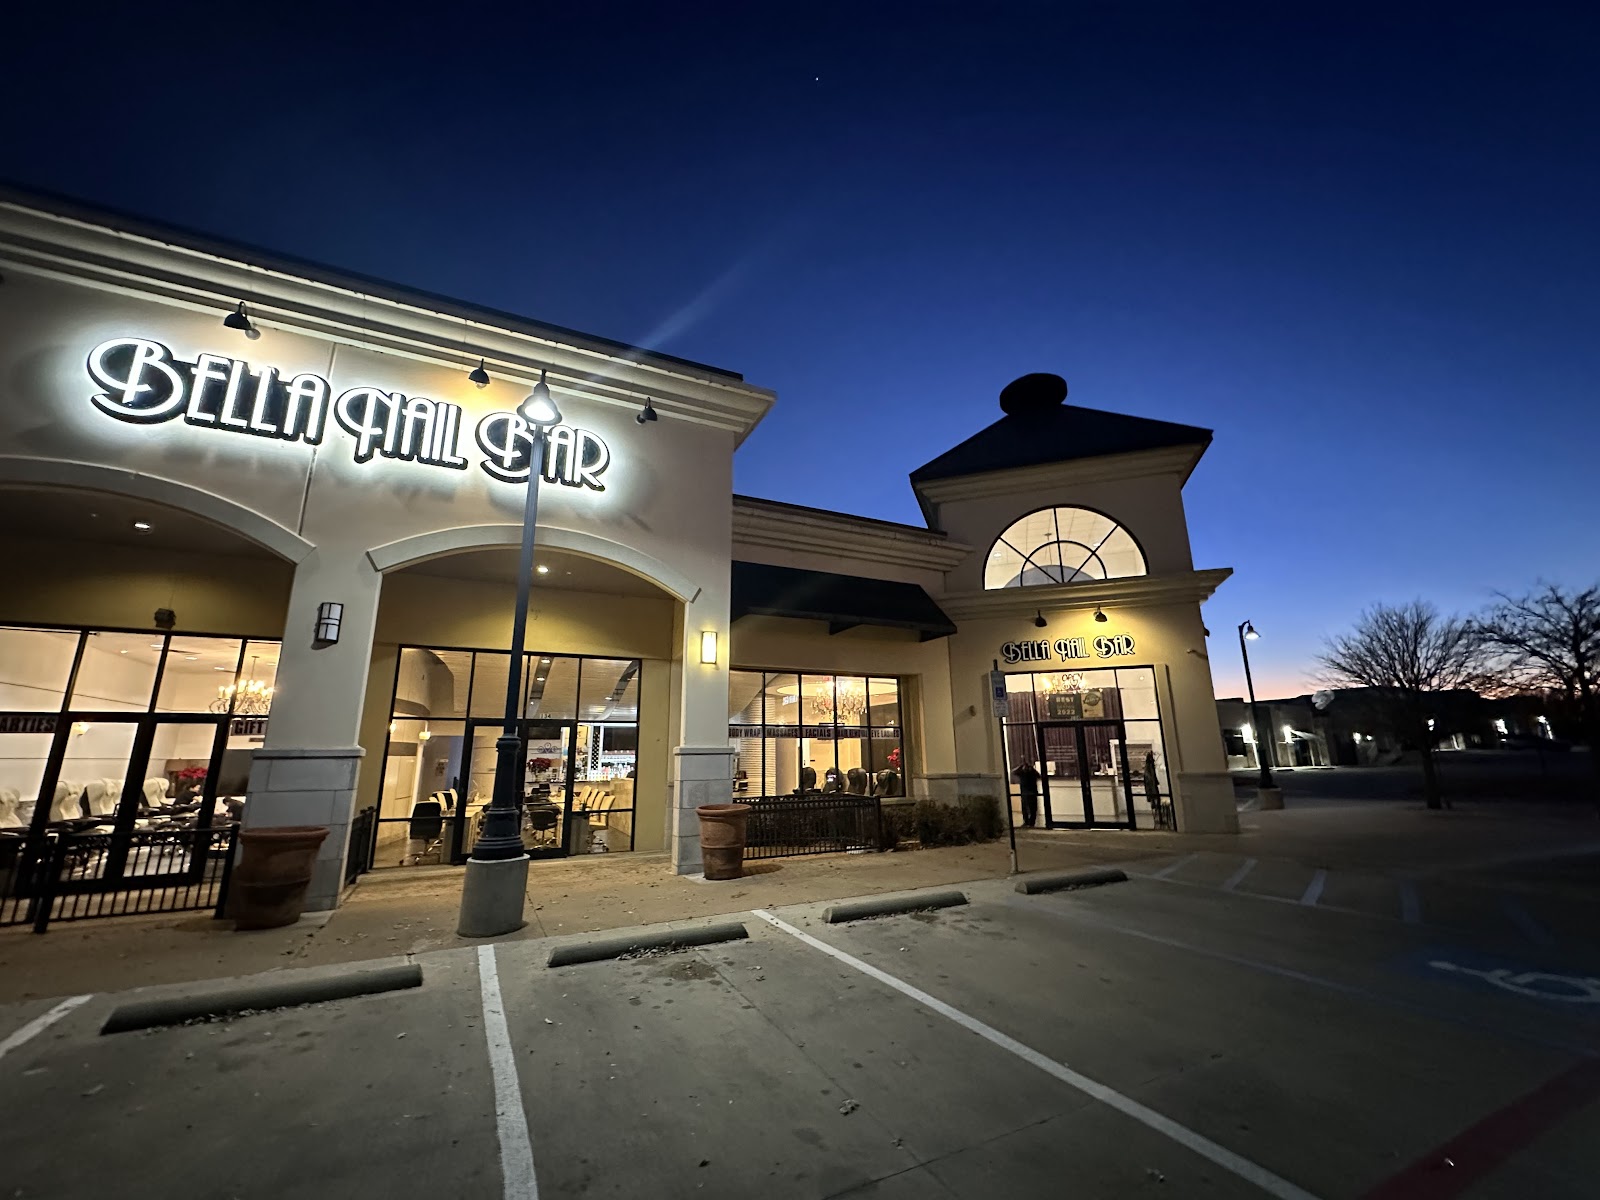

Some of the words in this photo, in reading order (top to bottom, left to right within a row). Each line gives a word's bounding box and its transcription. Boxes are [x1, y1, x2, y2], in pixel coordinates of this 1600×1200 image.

[87, 337, 331, 445] BELLA
[334, 386, 468, 470] NAIL
[475, 411, 610, 492] BAR
[1002, 640, 1051, 664] BELLA
[1053, 637, 1090, 662] NAIL
[1093, 635, 1136, 659] BAR
[234, 720, 265, 735] GIFT
[744, 728, 761, 738] WRAP
[805, 728, 831, 738] FACIALS
[871, 729, 880, 738] EYE
